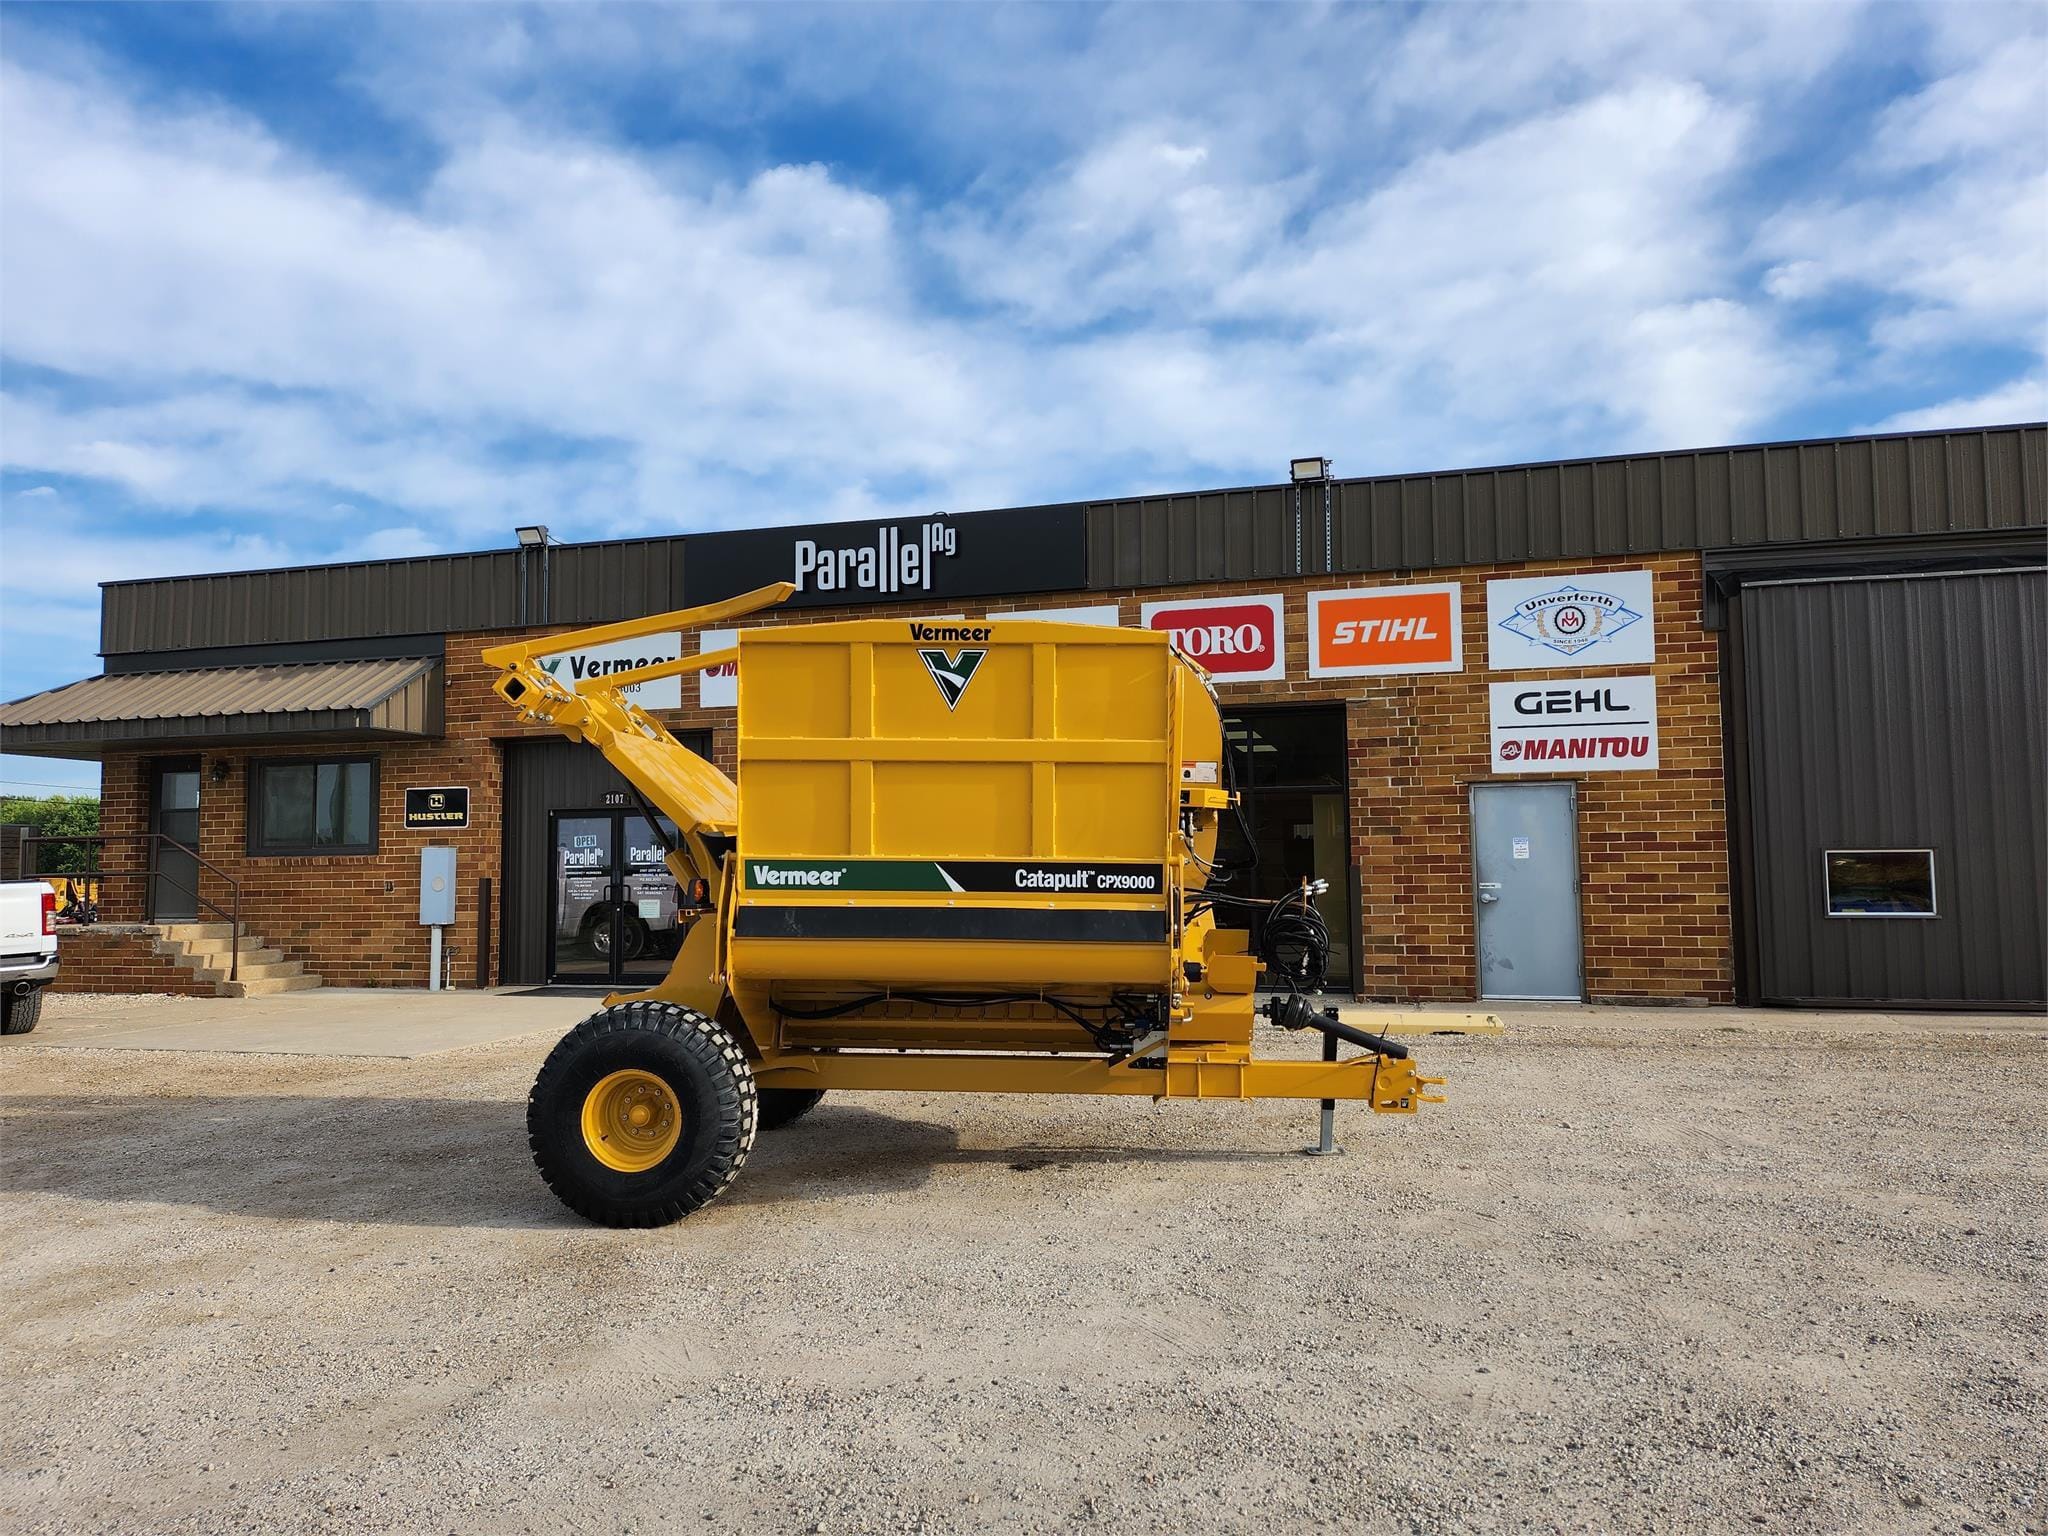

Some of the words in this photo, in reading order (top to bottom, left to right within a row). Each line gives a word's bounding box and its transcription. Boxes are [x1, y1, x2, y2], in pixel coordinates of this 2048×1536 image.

[795, 524, 931, 592] Parallel
[932, 522, 956, 556] Ag
[1524, 593, 1614, 612] Unverferth
[910, 623, 991, 641] Vermeer
[1331, 616, 1438, 645] STIHL
[1514, 688, 1631, 715] GEHL
[1523, 736, 1649, 760] MANITOU
[605, 794, 624, 804] 2107
[408, 812, 464, 821] HUSTLER
[575, 836, 596, 847] OPEN
[564, 848, 598, 865] Parallel
[630, 845, 665, 862] Parallel
[753, 865, 842, 886] Vermeer
[1097, 875, 1155, 889] CPX9000
